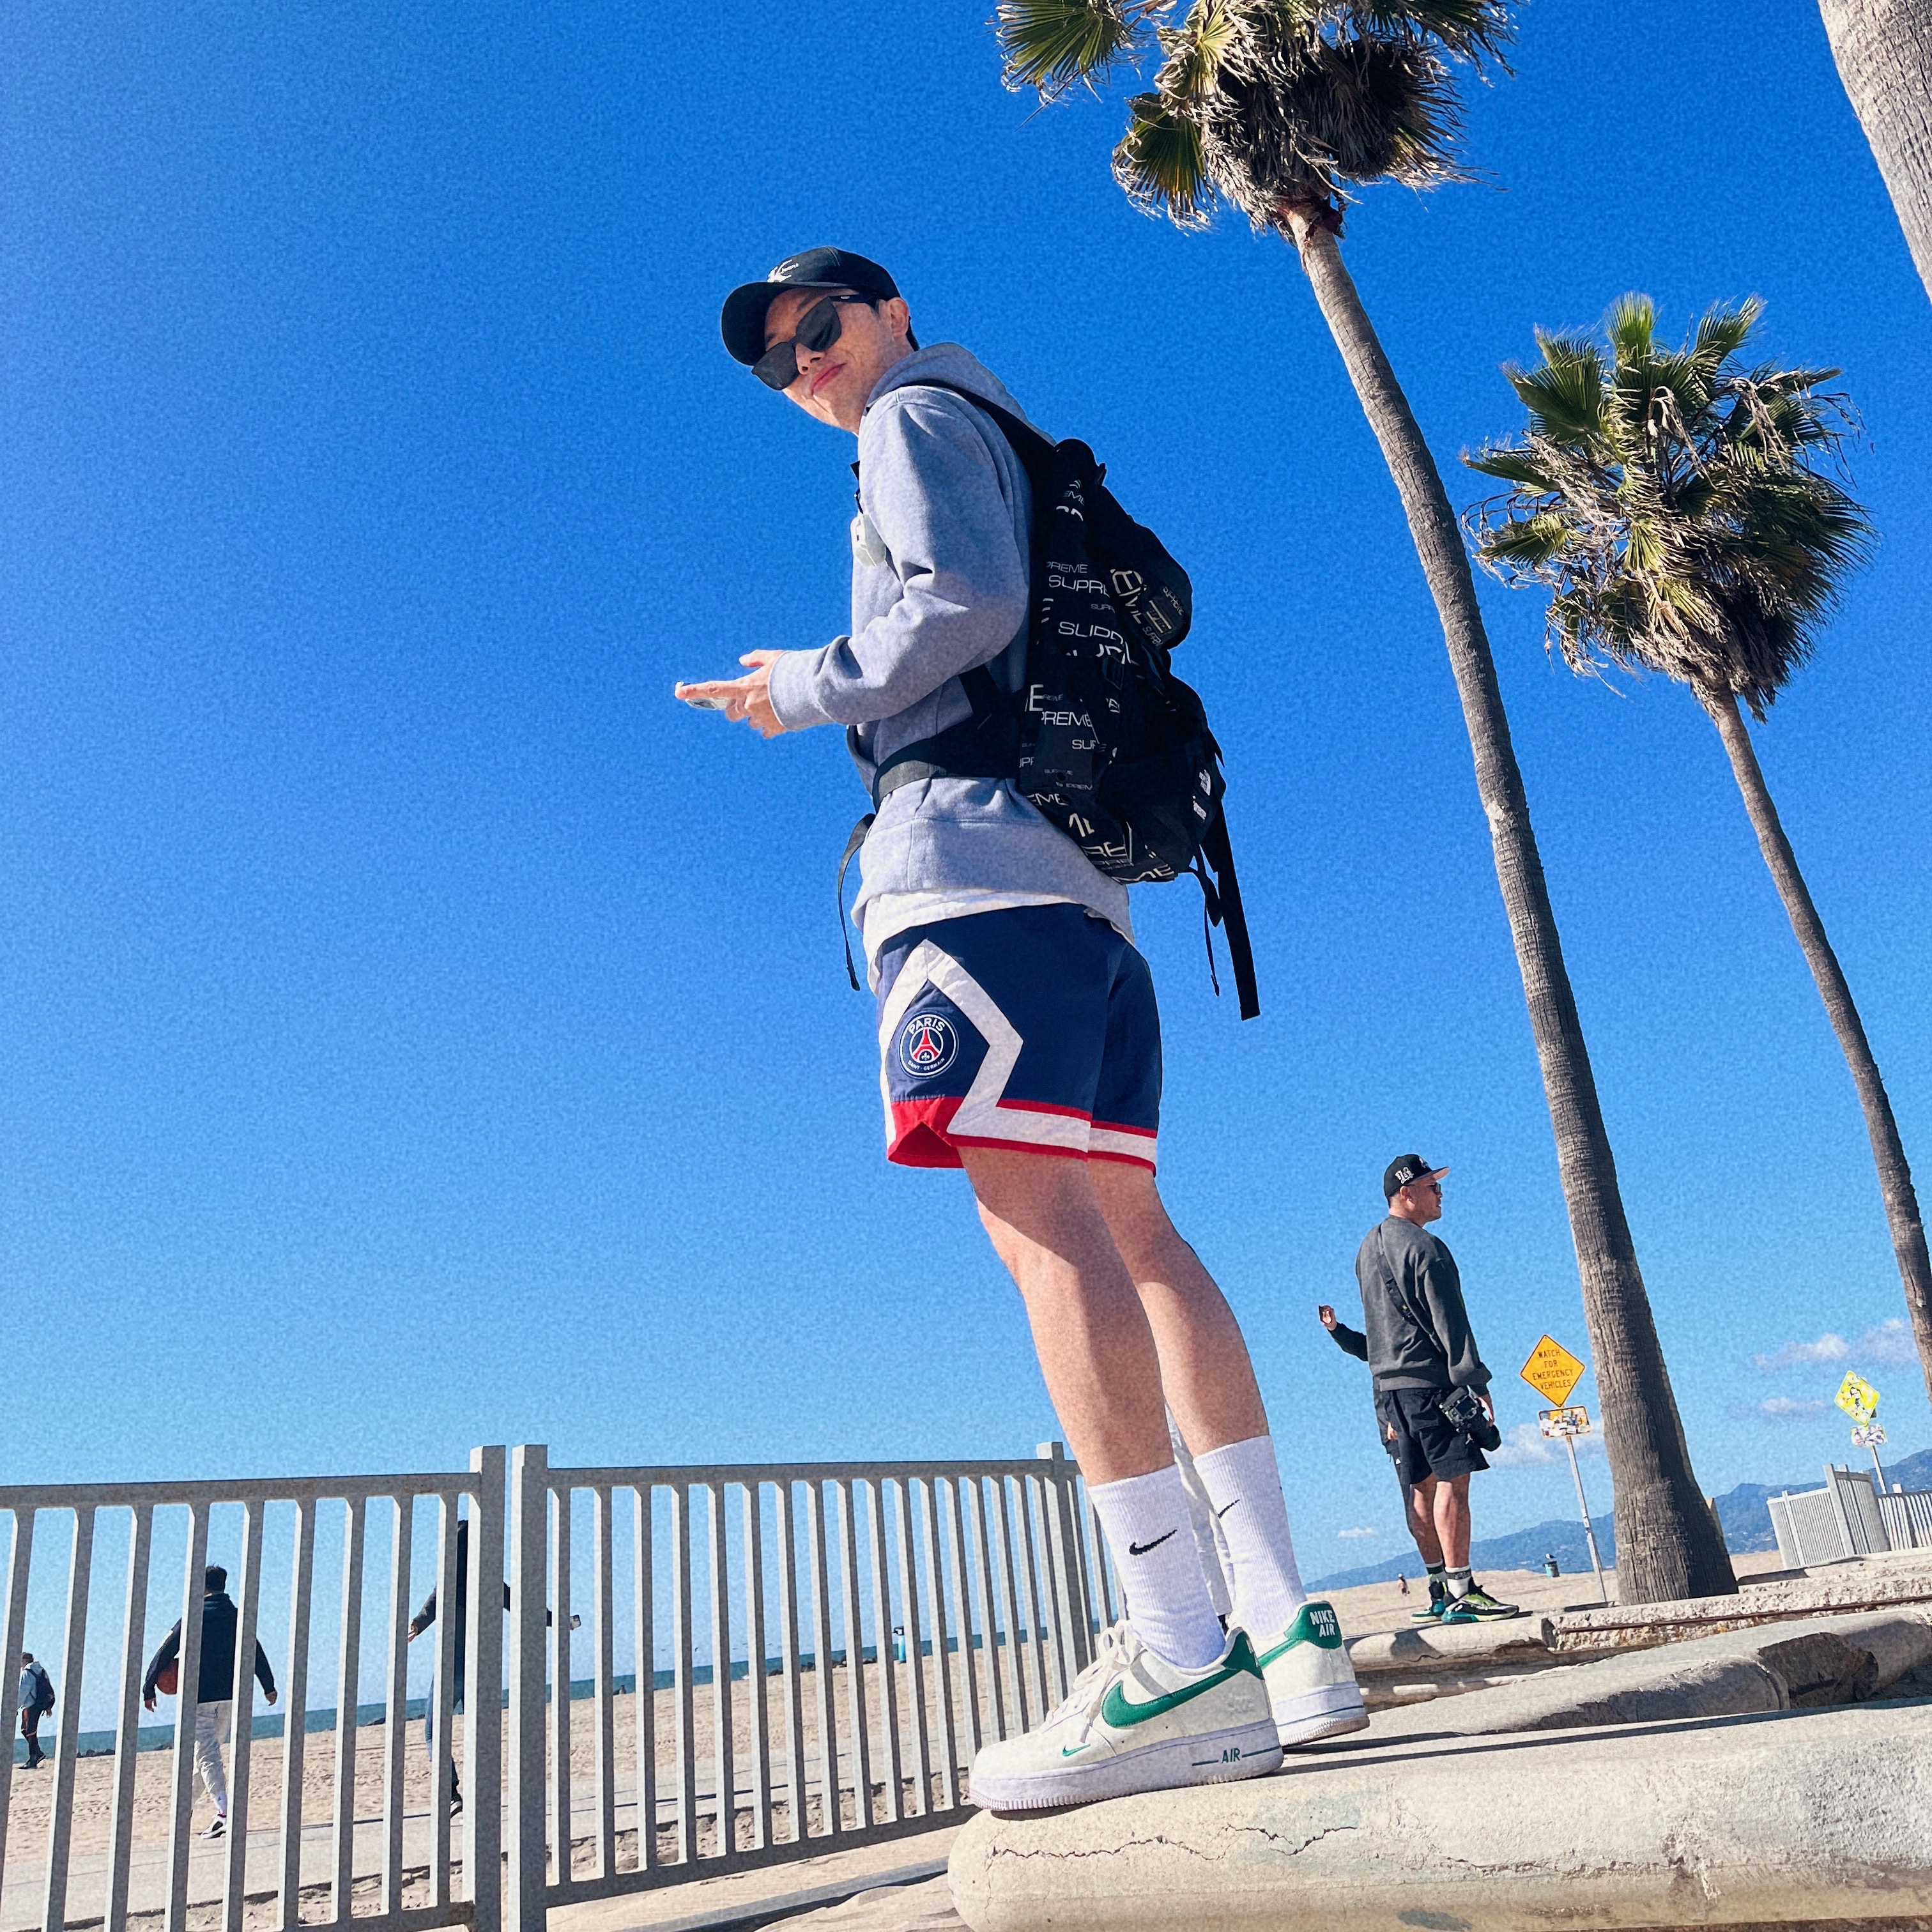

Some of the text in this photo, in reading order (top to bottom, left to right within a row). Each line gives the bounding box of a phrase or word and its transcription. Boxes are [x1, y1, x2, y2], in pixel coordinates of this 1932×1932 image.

[908, 1017, 946, 1035] PARIS
[1537, 1349, 1561, 1358] WATCH
[1544, 1360, 1558, 1368] FOR
[1532, 1369, 1574, 1381] EMERGENCY
[1540, 1379, 1572, 1390] VEHICLES
[1309, 1609, 1335, 1625] NIKE
[1319, 1623, 1335, 1637] AIR
[1221, 1747, 1241, 1763] AIR
